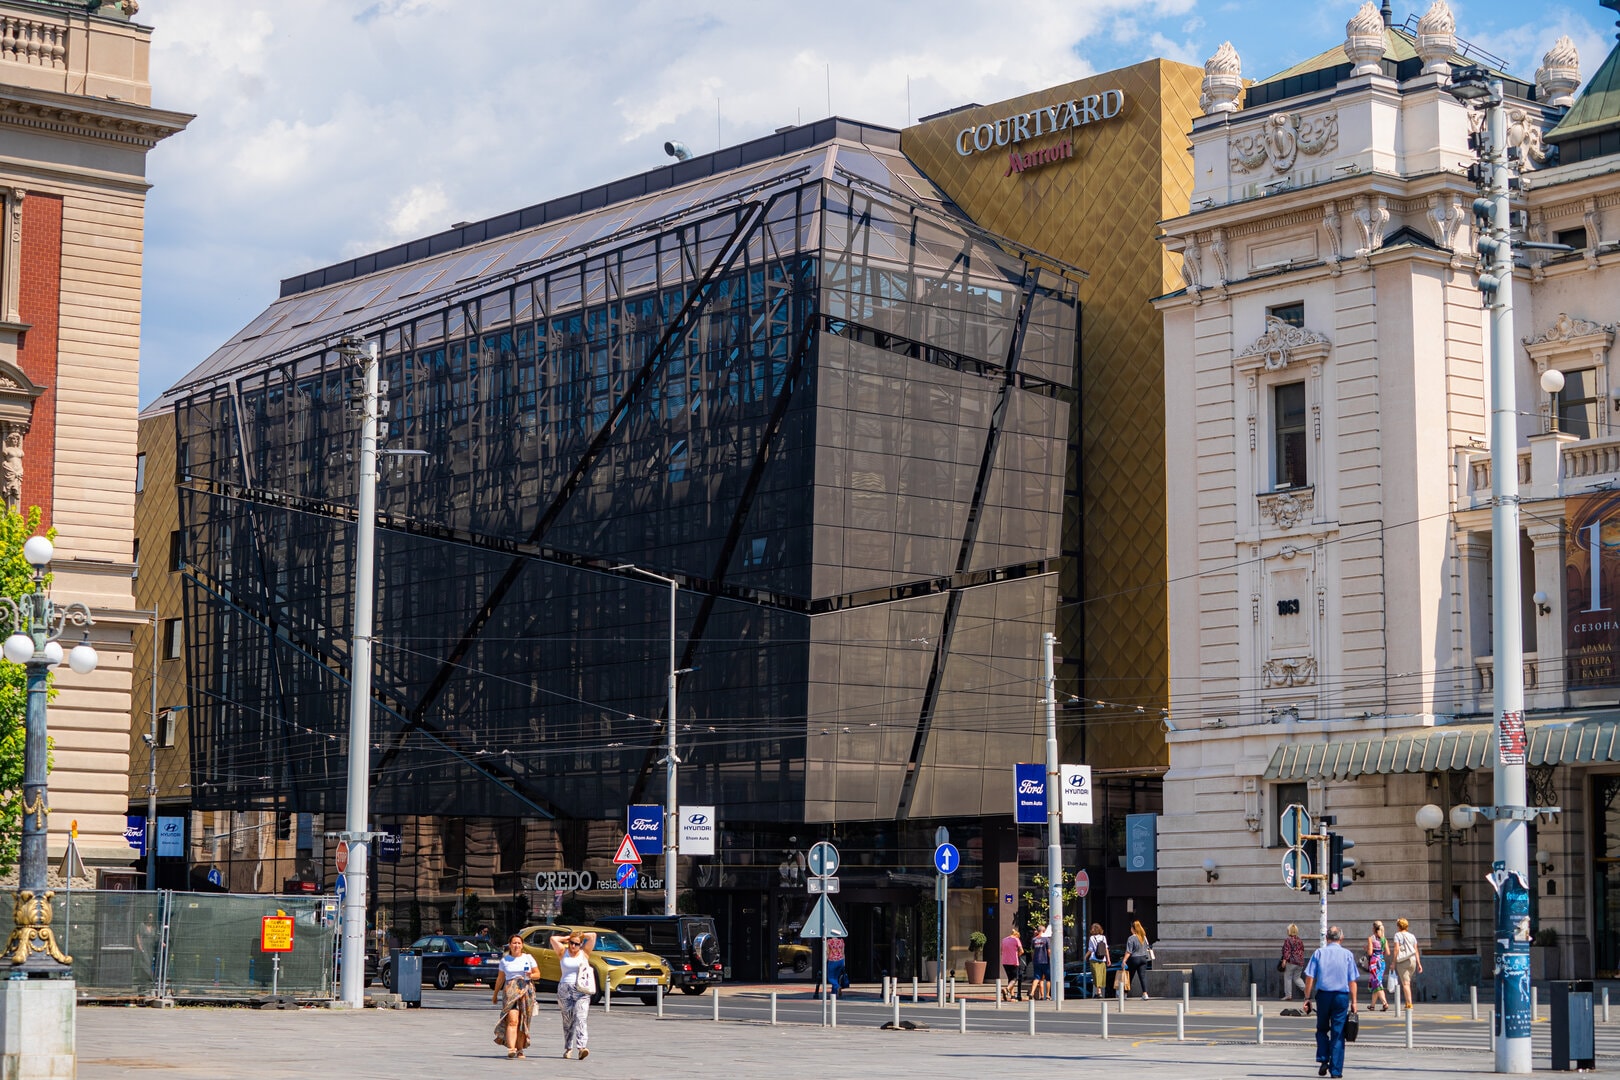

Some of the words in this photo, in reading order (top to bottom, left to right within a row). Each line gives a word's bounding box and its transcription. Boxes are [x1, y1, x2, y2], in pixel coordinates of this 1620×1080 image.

[956, 89, 1124, 156] COURTYARD
[1004, 139, 1073, 177] Marriott
[1573, 621, 1619, 633] СЕЗОНА
[1581, 656, 1611, 666] ОПЕРА
[1018, 780, 1044, 794] Ford
[631, 818, 659, 831] Ford
[122, 826, 143, 837] Ford
[536, 871, 592, 891] CREDO
[640, 876, 647, 889] &
[649, 876, 664, 889] bar
